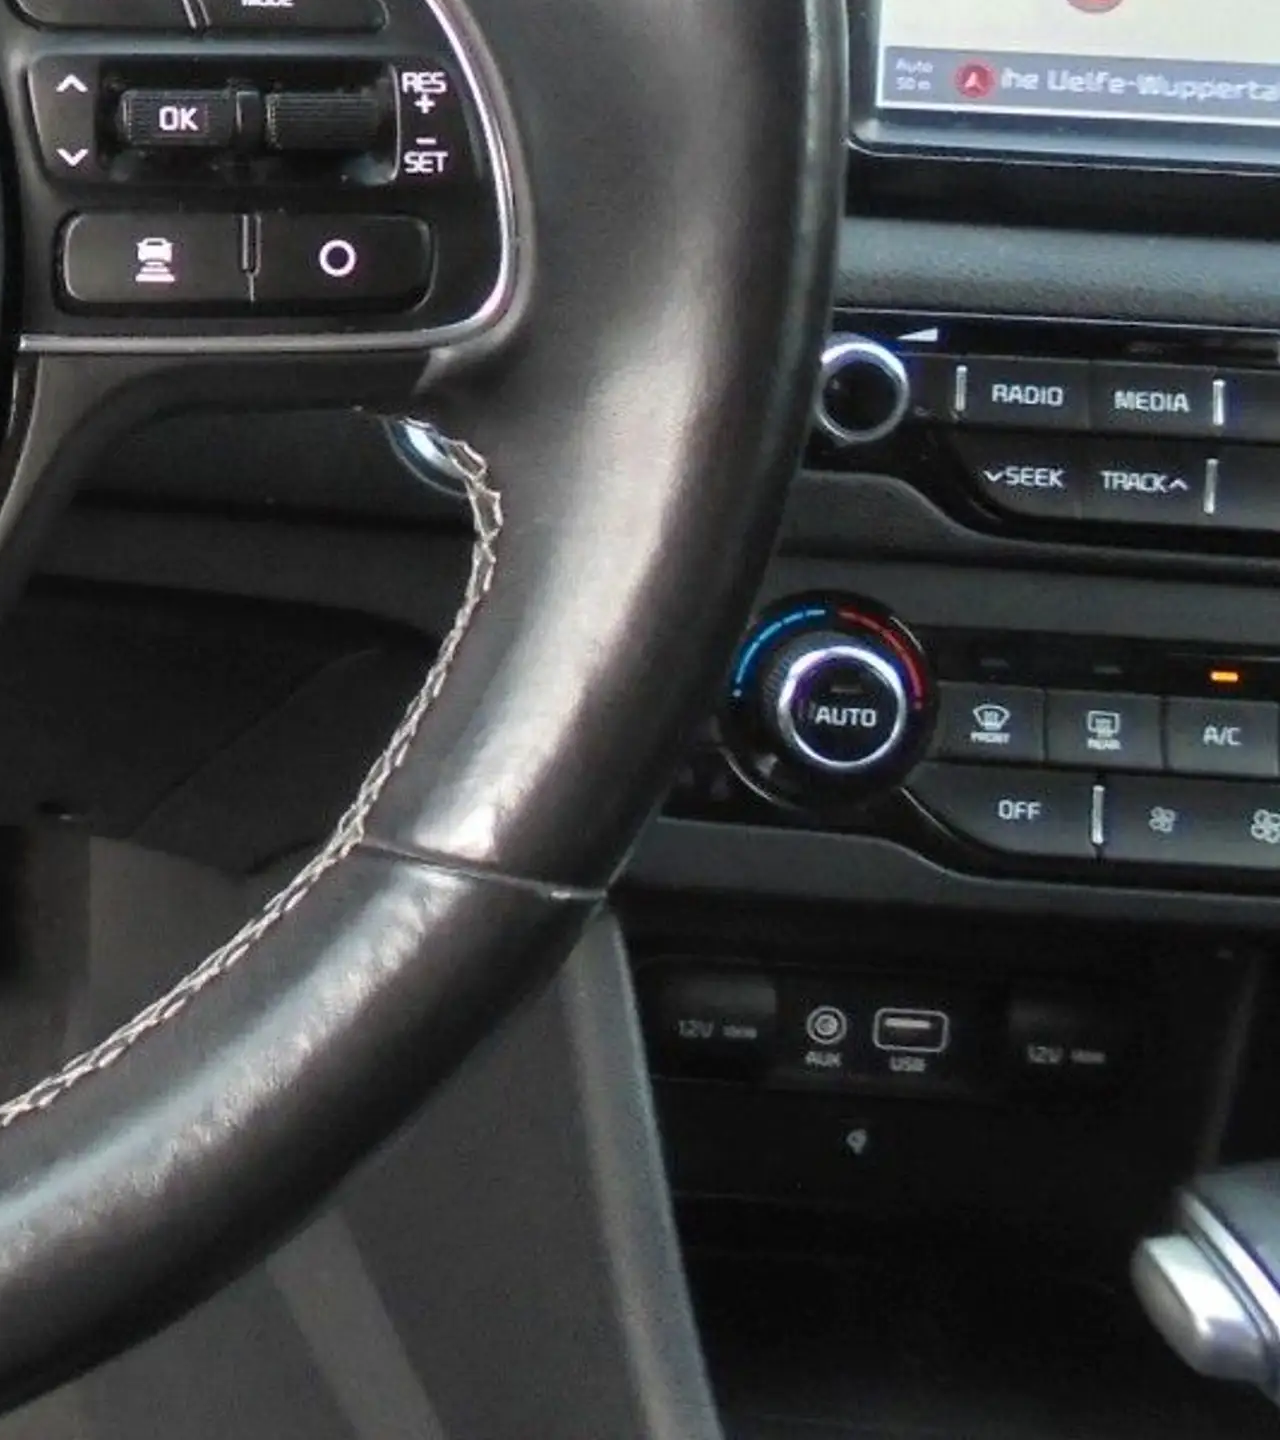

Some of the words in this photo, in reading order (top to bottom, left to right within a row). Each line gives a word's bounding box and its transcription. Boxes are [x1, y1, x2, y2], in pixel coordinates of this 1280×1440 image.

[401, 71, 447, 93] RES
[159, 106, 199, 132] OK
[403, 151, 448, 173] SET
[991, 383, 1064, 408] RADIO
[1114, 389, 1190, 413] MEDIA
[1006, 467, 1064, 488] SEEK
[1101, 471, 1167, 494] TRACK
[815, 705, 877, 728] AUTO
[1202, 725, 1242, 747] A/C
[998, 798, 1041, 821] OFF
[805, 1051, 842, 1067] AUX
[889, 1057, 927, 1072] USB
